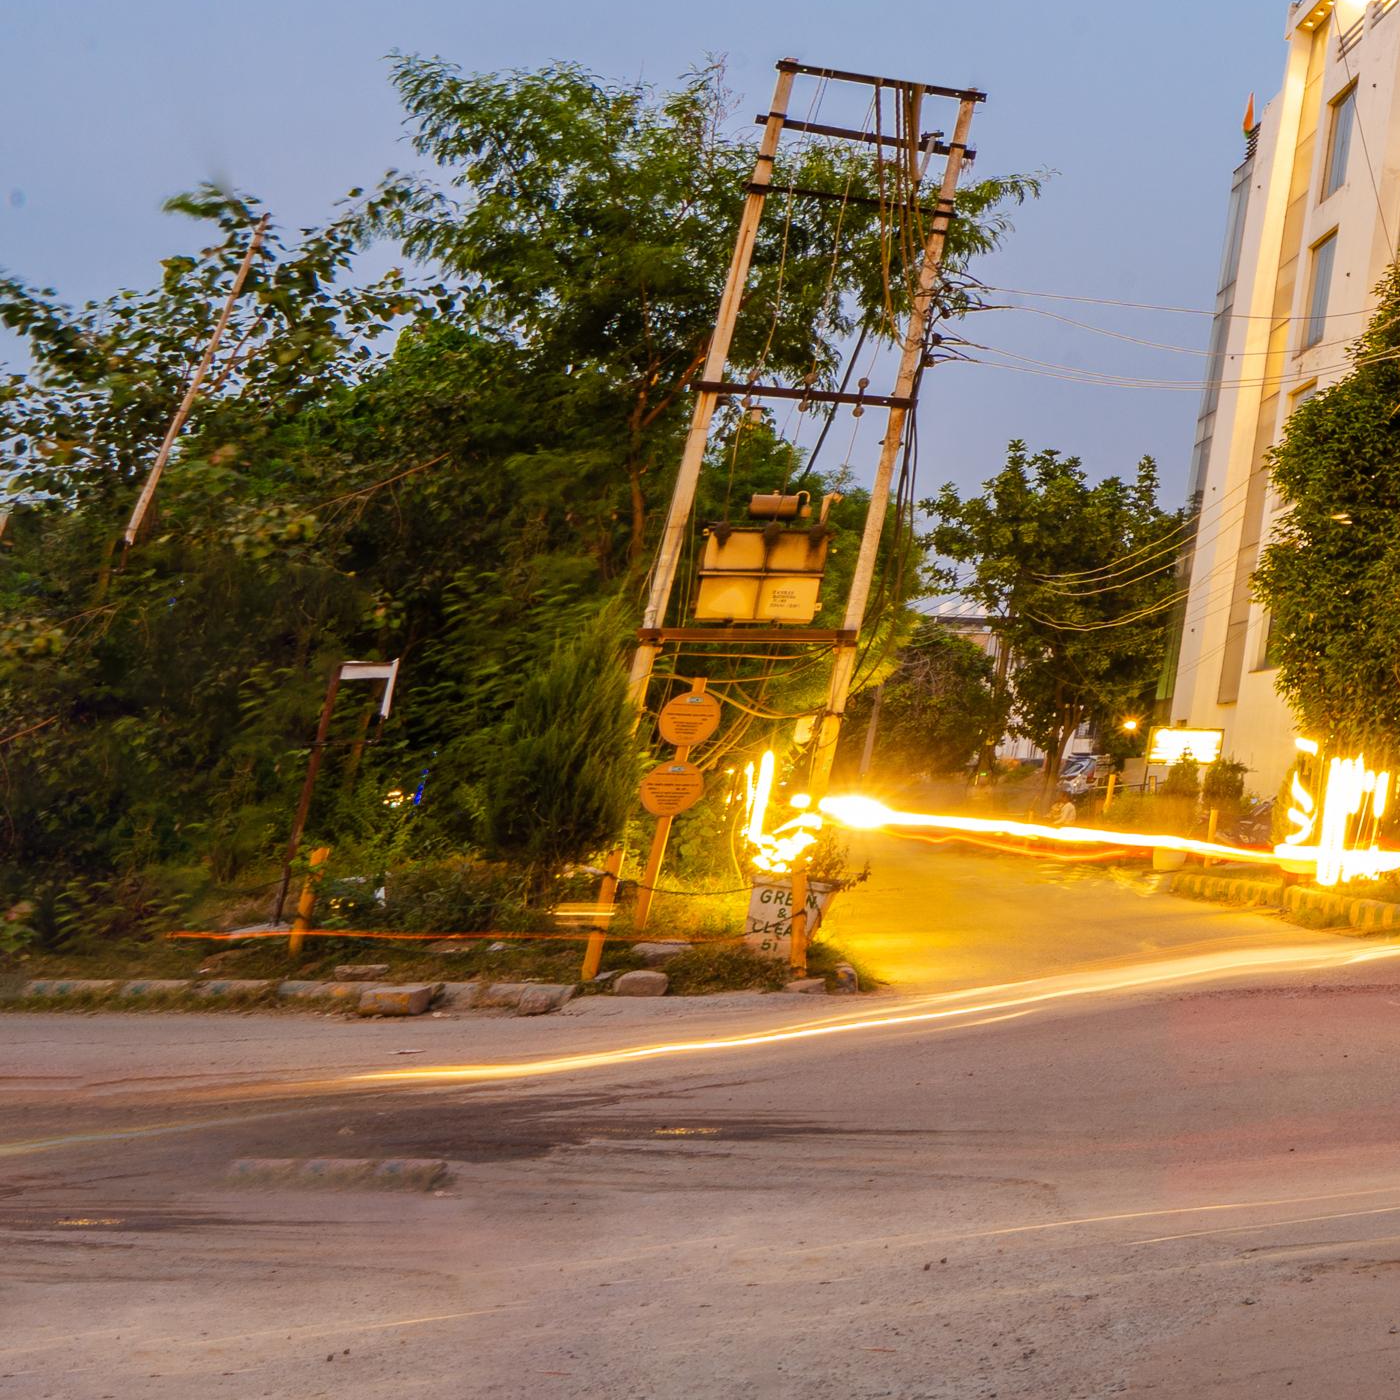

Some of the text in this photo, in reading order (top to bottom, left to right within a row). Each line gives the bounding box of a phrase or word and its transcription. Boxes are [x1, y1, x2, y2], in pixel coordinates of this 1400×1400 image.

[760, 889, 817, 909] GREN
[777, 907, 787, 919] &
[752, 921, 793, 936] CLEA
